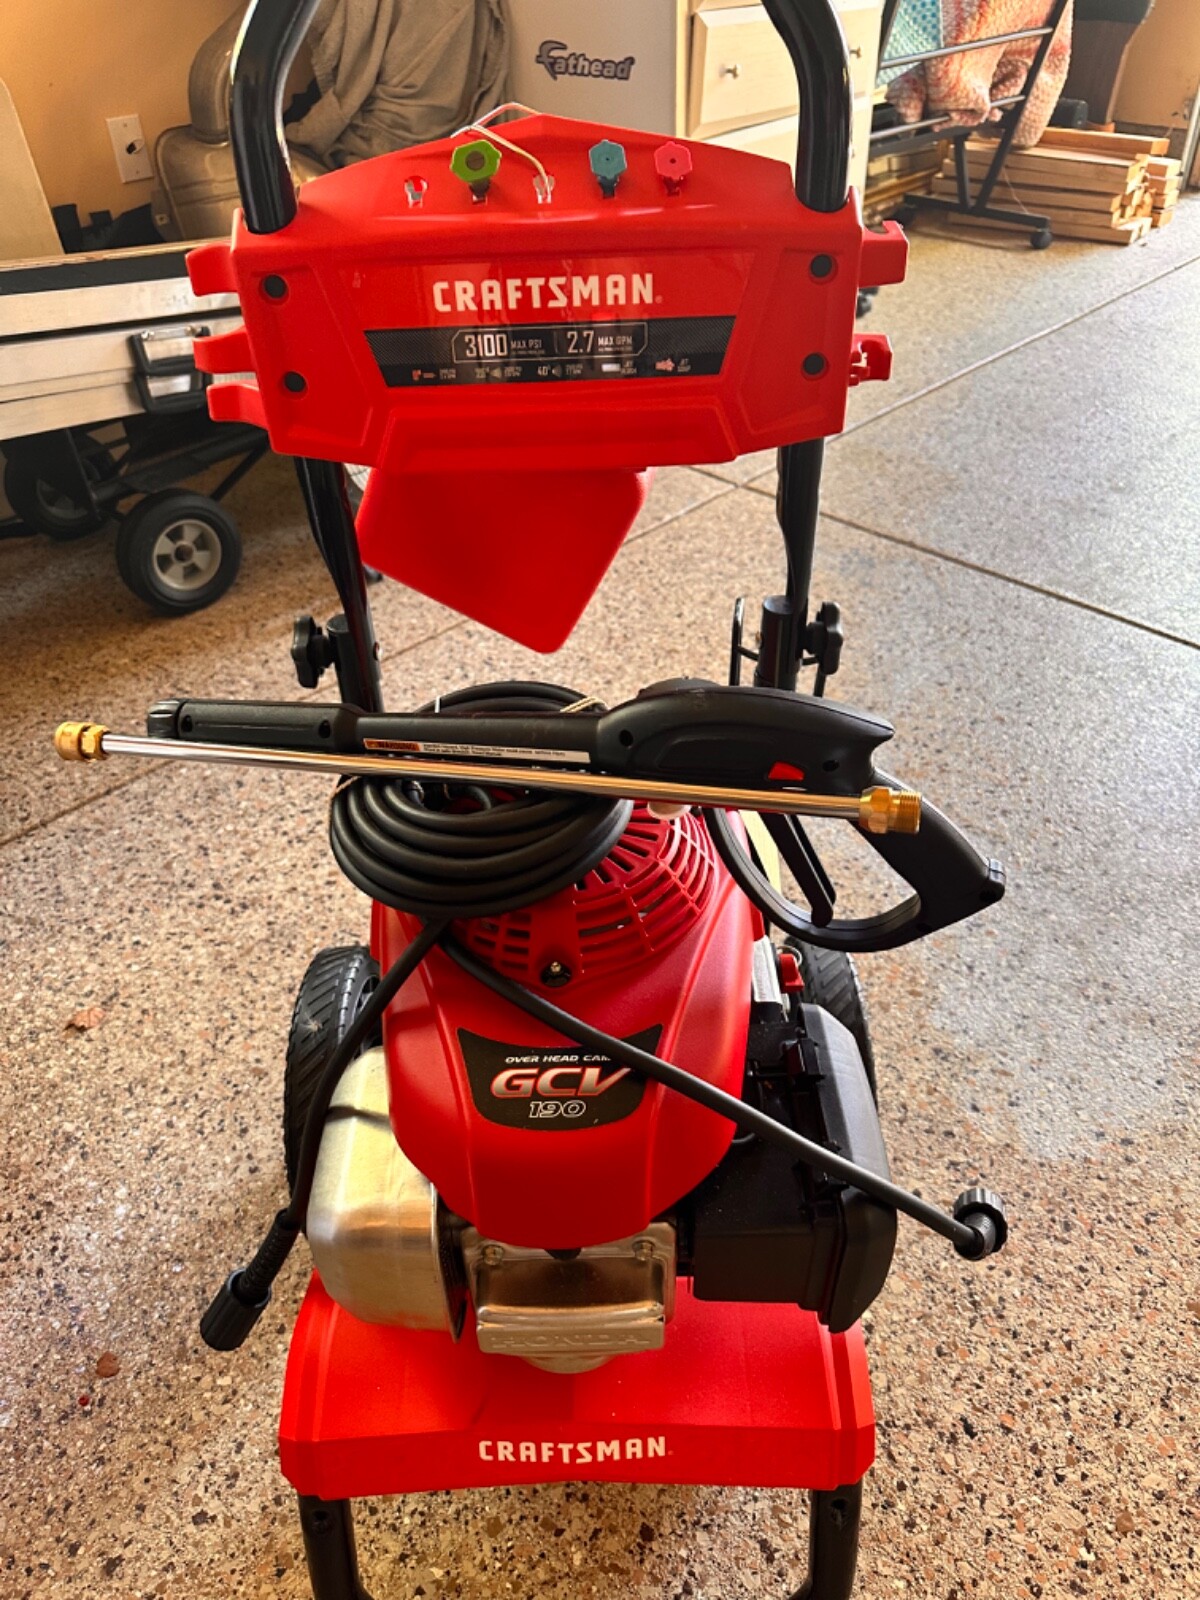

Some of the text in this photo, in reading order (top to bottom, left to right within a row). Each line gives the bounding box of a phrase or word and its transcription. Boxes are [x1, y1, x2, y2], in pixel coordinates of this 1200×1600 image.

[535, 40, 635, 81] Fathead
[433, 273, 653, 312] CRAFTSMAN
[464, 333, 508, 357] 3100
[510, 339, 526, 349] MAX
[528, 338, 542, 348] PSI
[567, 330, 594, 353] 2.7
[597, 336, 614, 346] MAX
[616, 335, 632, 345] GPM
[504, 1055, 540, 1064] OVER
[543, 1054, 579, 1063] HEAD
[490, 1067, 631, 1098] GCV
[529, 1100, 586, 1118] 190
[479, 1436, 666, 1464] CRAFTSMAN
